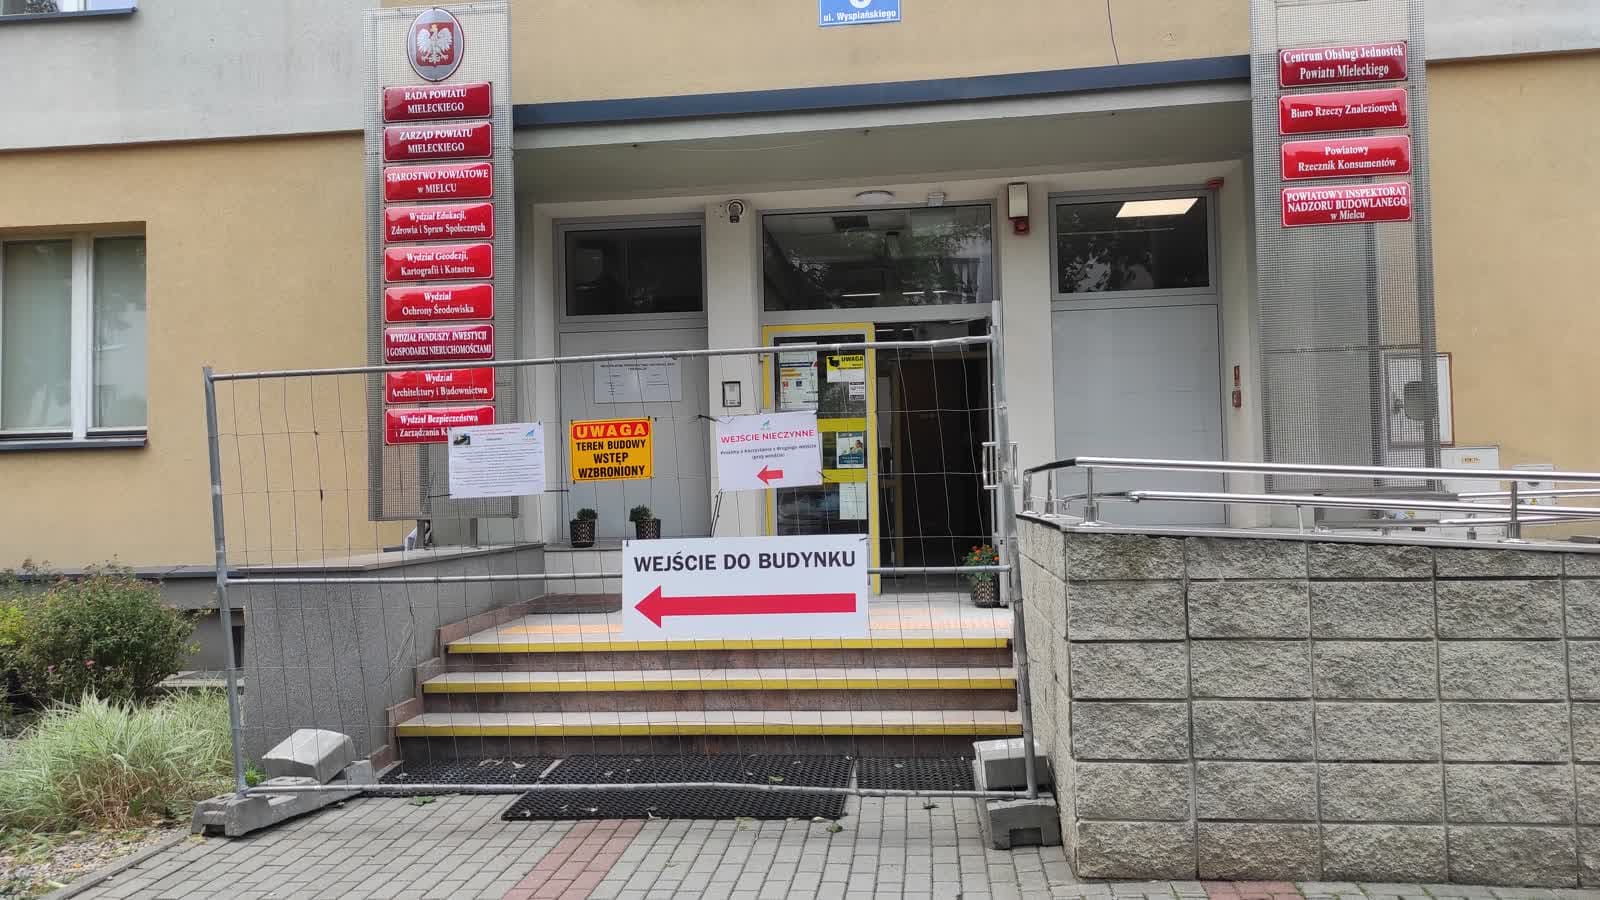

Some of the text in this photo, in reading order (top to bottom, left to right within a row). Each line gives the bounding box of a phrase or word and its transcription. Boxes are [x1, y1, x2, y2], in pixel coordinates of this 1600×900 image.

[823, 13, 834, 21] ul.
[1283, 45, 1403, 64] Centrum Obsługi Jednostek
[1300, 63, 1389, 80] Powiatu Mieleckiego
[405, 88, 466, 100] RADA POWIATU
[408, 102, 464, 114] MIELECKIEGO
[1291, 102, 1398, 118] Biuro Rzeczy Znalezionych
[400, 128, 473, 140] ZARZĄD POWIATU
[408, 142, 464, 154] MIELECKIEGO
[1325, 145, 1368, 156] Powiatowy
[1298, 158, 1397, 172] Rzecznik Konsumentów
[387, 170, 488, 182] STAROSTWO POWIATOWE
[426, 184, 457, 193] MIELCU
[1287, 186, 1407, 202] POWIATOWY INSPEKTORAT
[1288, 196, 1407, 212] NADZORU BUDOWLANEGO
[409, 210, 466, 222] Wydział Edukacji,
[1340, 210, 1365, 220] Mielcu
[392, 222, 486, 236] Zdrowia i Spraw Społecznych
[407, 250, 468, 262] Wydział Geodezji,
[401, 264, 474, 276] Kartografii i Katastru
[424, 292, 452, 302] Wydział
[402, 304, 474, 316] Ochrony Środowiska
[390, 333, 416, 342] WYDZIAŁ
[430, 344, 492, 355] NIERUCHOMOŚCIAMI
[425, 373, 452, 384] Wydział
[392, 386, 488, 397] Architektury i Budownictwa
[400, 414, 478, 425] Wydział Bezpieczeństwa
[400, 428, 440, 438] Zarządzania
[576, 424, 646, 438] UWAGA
[762, 430, 815, 440] NIECZYNNE
[576, 440, 646, 452] TEREN BUDOWY
[594, 452, 628, 465] WSTĘP
[578, 466, 645, 478] WZBRONIONY
[634, 551, 856, 572] WEJŚCIE DO BUDYNKU
